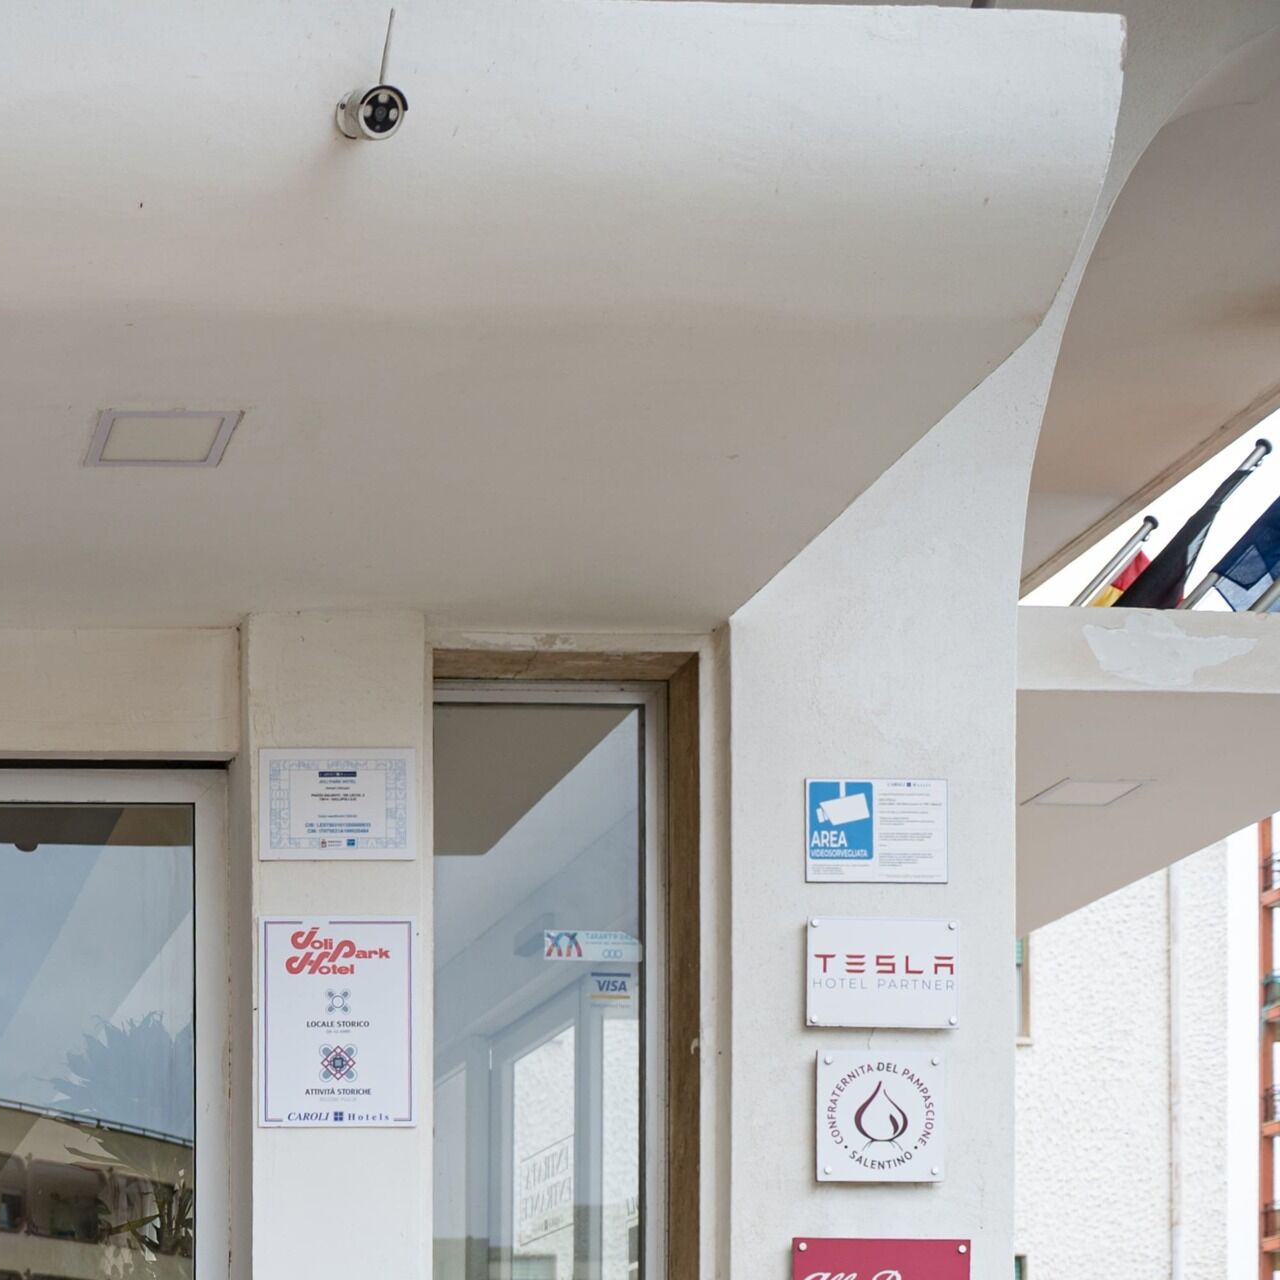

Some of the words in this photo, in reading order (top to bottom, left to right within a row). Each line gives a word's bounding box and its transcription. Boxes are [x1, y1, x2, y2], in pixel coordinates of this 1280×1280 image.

[811, 830, 848, 848] AREA
[290, 927, 333, 950] Joli
[328, 940, 390, 963] Park
[285, 950, 355, 975] Hotel
[814, 954, 954, 975] TESLA
[596, 979, 628, 992] VISA
[812, 977, 867, 989] HOTEL
[877, 978, 955, 991] PARTNER
[306, 1020, 334, 1028] LOCALE
[336, 1020, 370, 1028] STORICO
[336, 1088, 372, 1096] STORICHE
[827, 1063, 874, 1145] CONFRATERNITA
[876, 1061, 899, 1074] DEL
[901, 1068, 936, 1147] PAMPASCIONE
[287, 1111, 330, 1122] CAROLI
[347, 1111, 390, 1122] Hotels
[848, 1150, 914, 1170] SALENTINO
